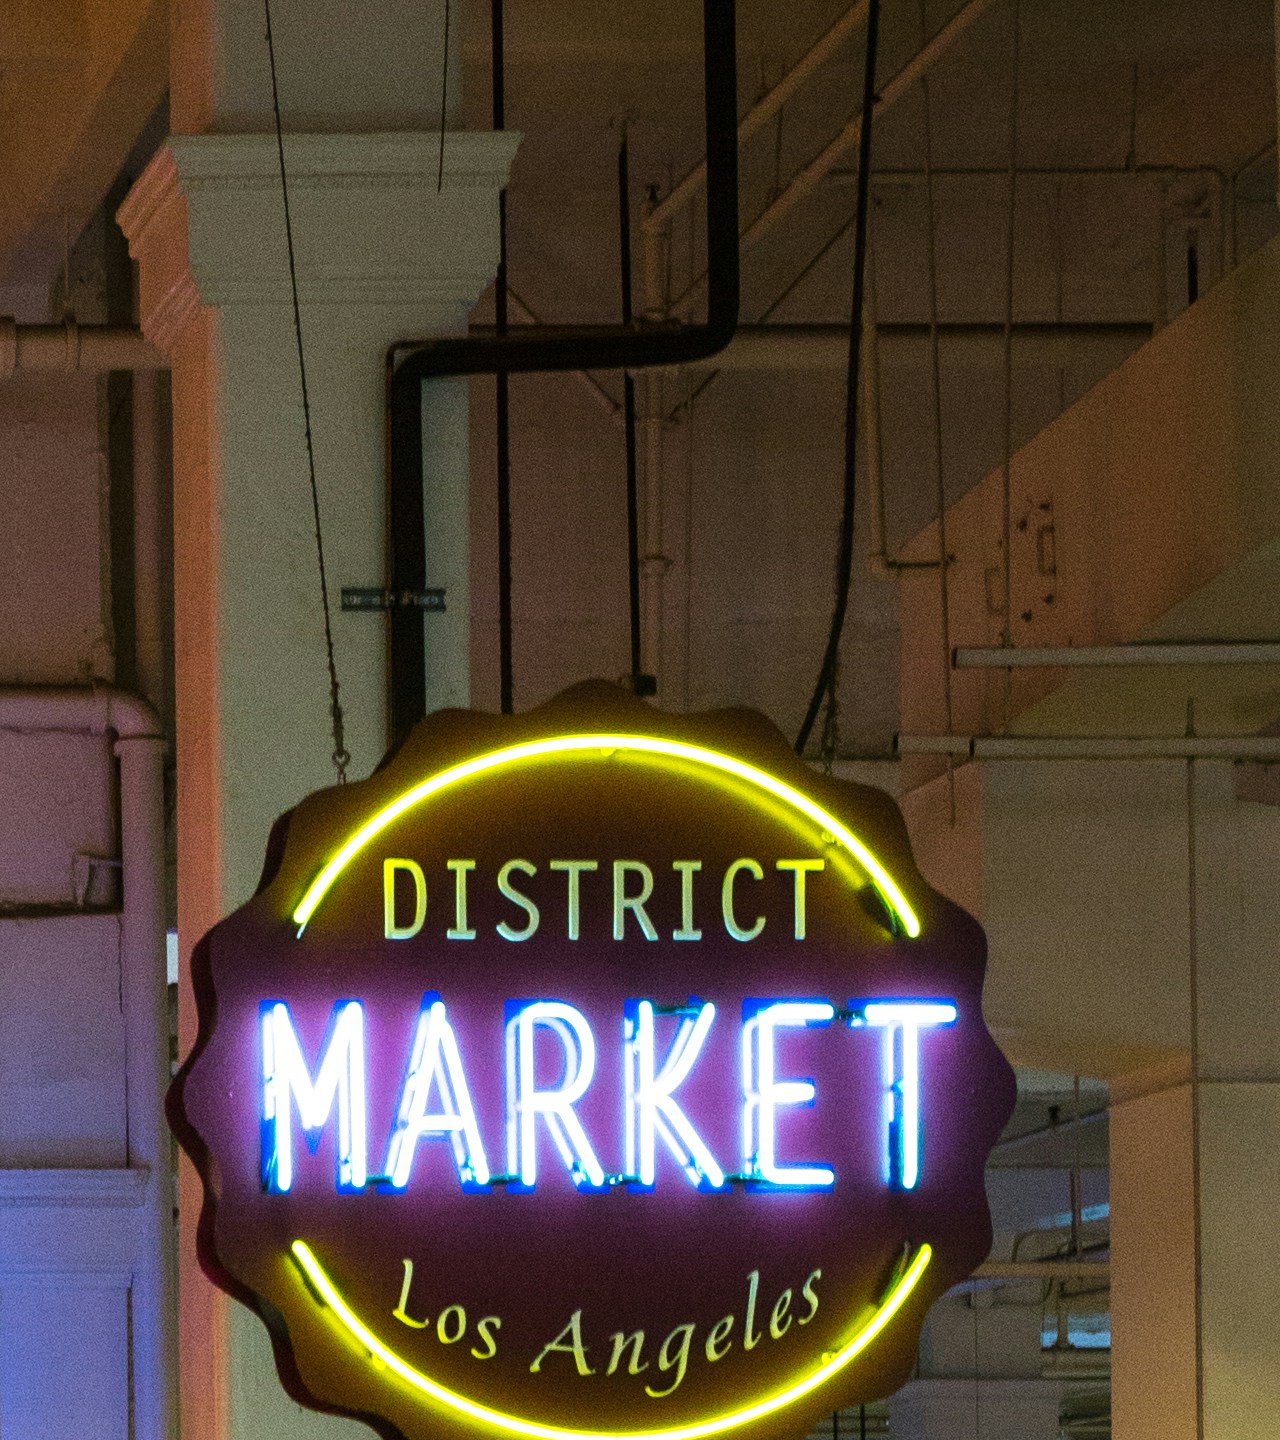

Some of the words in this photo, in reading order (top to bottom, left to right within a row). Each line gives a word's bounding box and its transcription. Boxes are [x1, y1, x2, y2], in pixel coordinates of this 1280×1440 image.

[382, 857, 825, 941] DISTRICT
[260, 992, 957, 1195] MARKET
[391, 1260, 503, 1359] Los
[530, 1268, 823, 1398] Angeles
